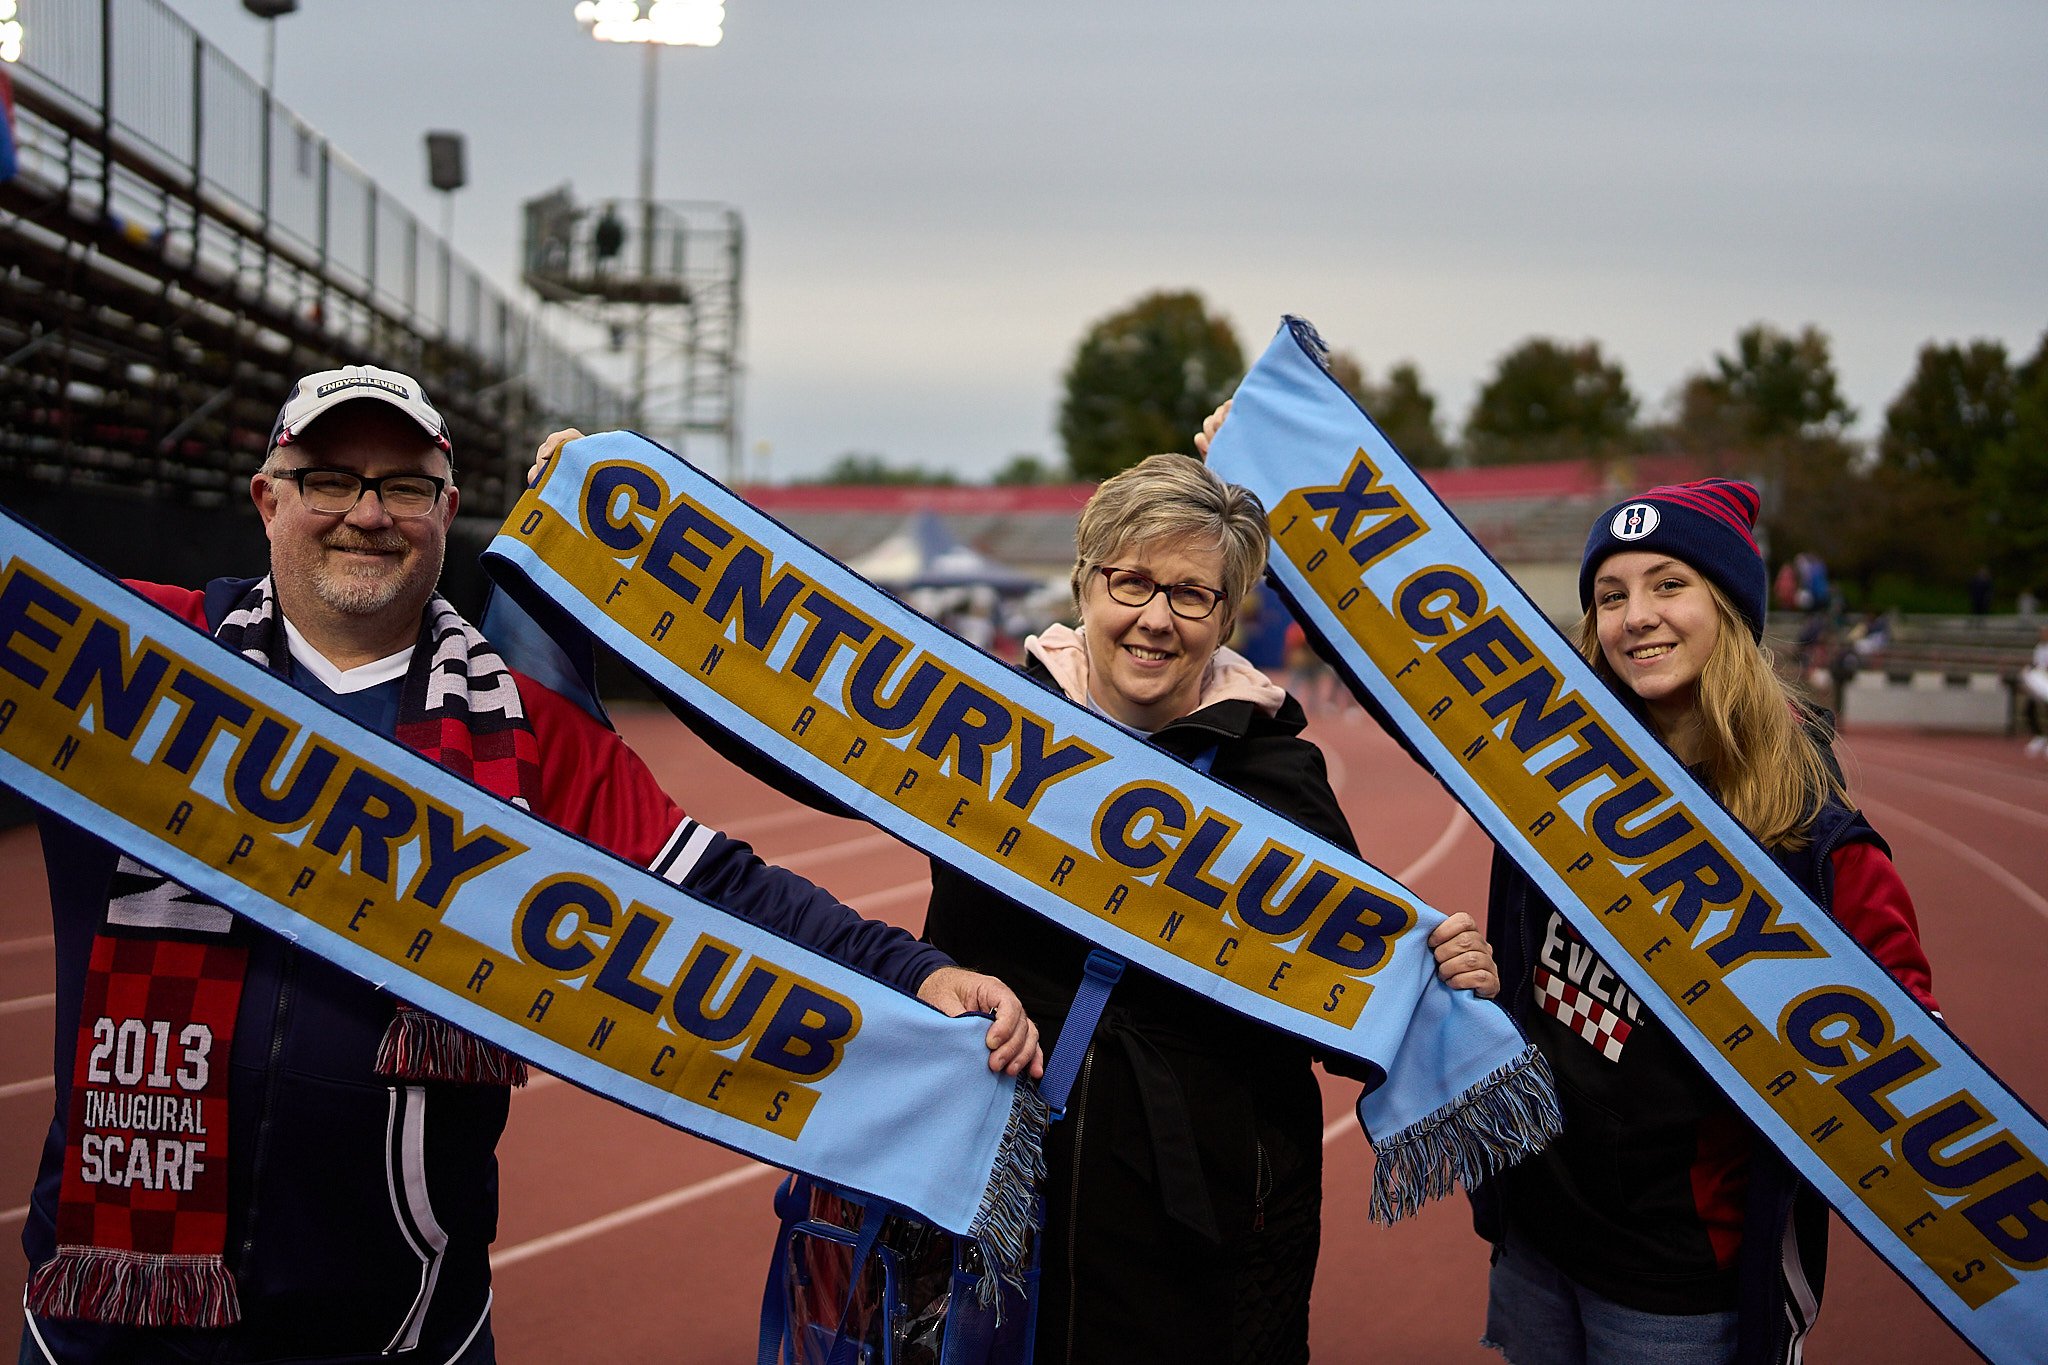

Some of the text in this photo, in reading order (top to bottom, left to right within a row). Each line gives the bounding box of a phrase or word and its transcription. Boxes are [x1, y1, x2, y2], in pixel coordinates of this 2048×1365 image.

[321, 378, 404, 394] INDY ELEVEN
[0, 569, 511, 909] ENTURY
[521, 881, 853, 1075] CLUB
[0, 699, 80, 771] AN
[166, 800, 790, 1122] APPEARANCES
[586, 465, 1095, 809] CENTURY
[1100, 787, 1409, 970] CLUB
[606, 577, 724, 675] FAN
[792, 705, 1345, 1012] APPEARANCES
[1278, 515, 1986, 1284] 100 FAN APPEARANCES
[1303, 459, 2048, 1264] XI CENTURY CLUB
[81, 1134, 205, 1191] SCARF
[84, 1090, 207, 1135] INAUGURAL
[88, 1017, 213, 1091] 2013
